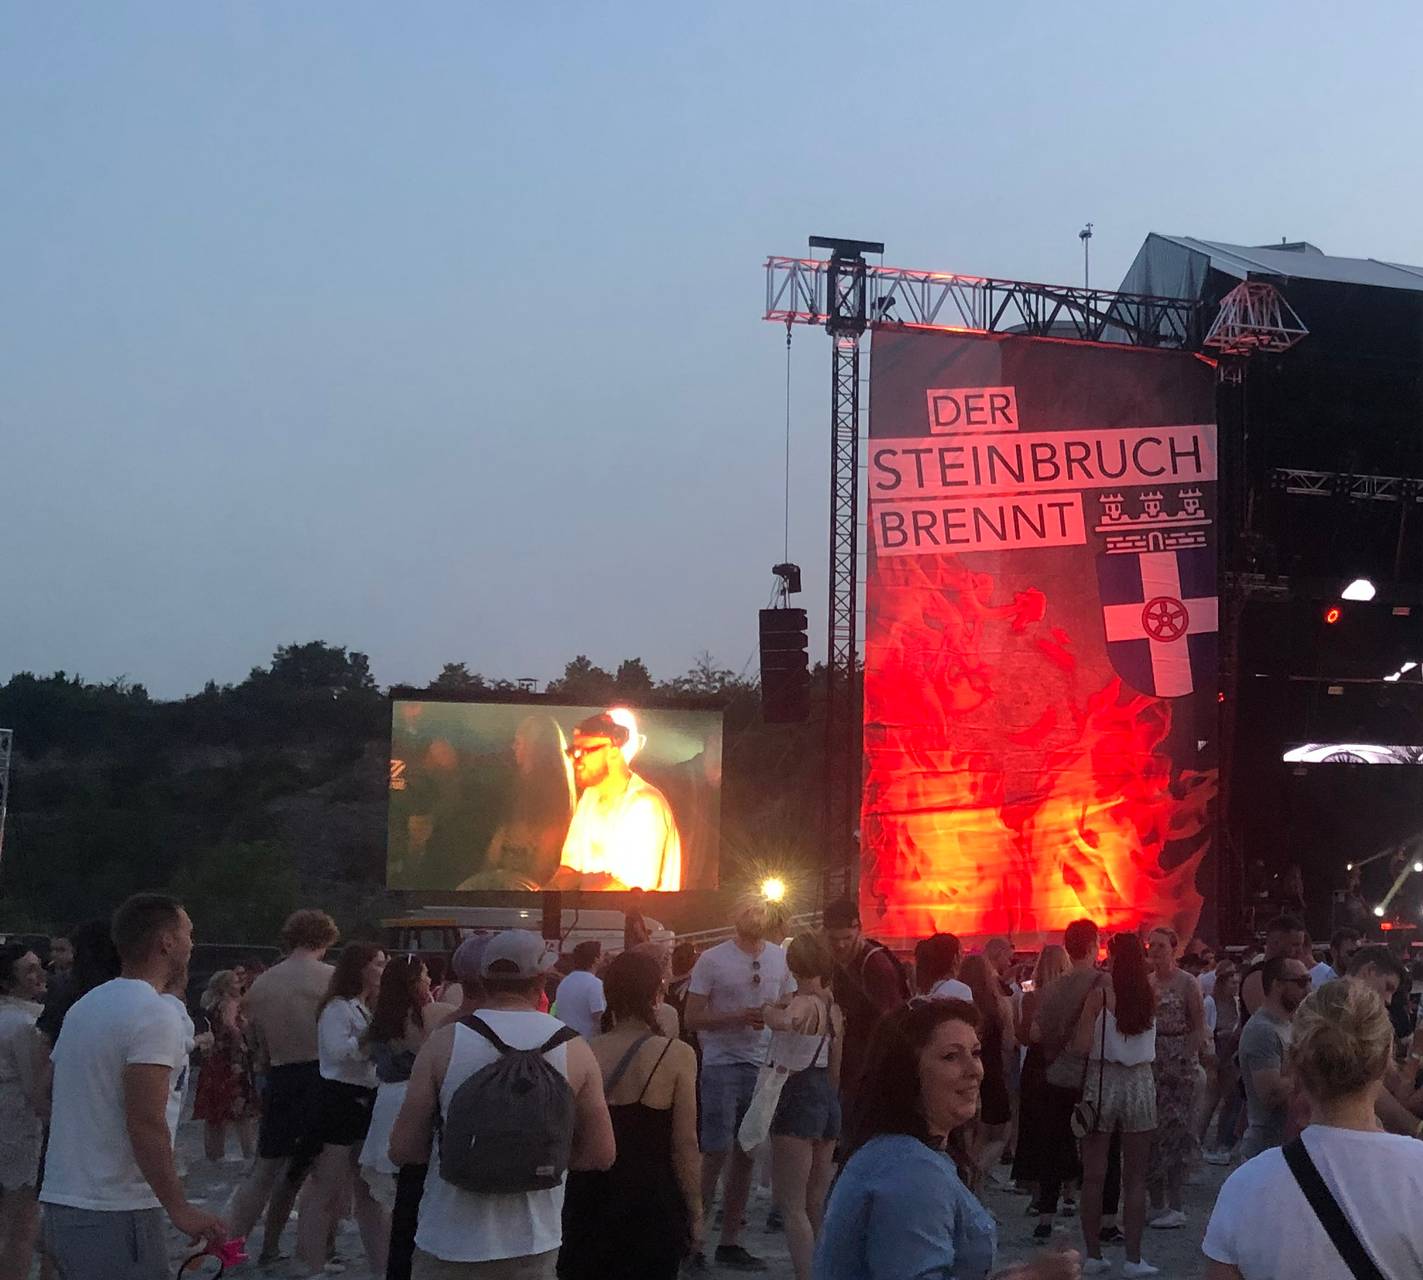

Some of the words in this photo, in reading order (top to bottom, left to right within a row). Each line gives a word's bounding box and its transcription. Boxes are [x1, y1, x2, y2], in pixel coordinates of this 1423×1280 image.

[932, 393, 1014, 427] DER
[872, 434, 1203, 491] STEINBRUCH
[880, 501, 1075, 549] BRENNT
